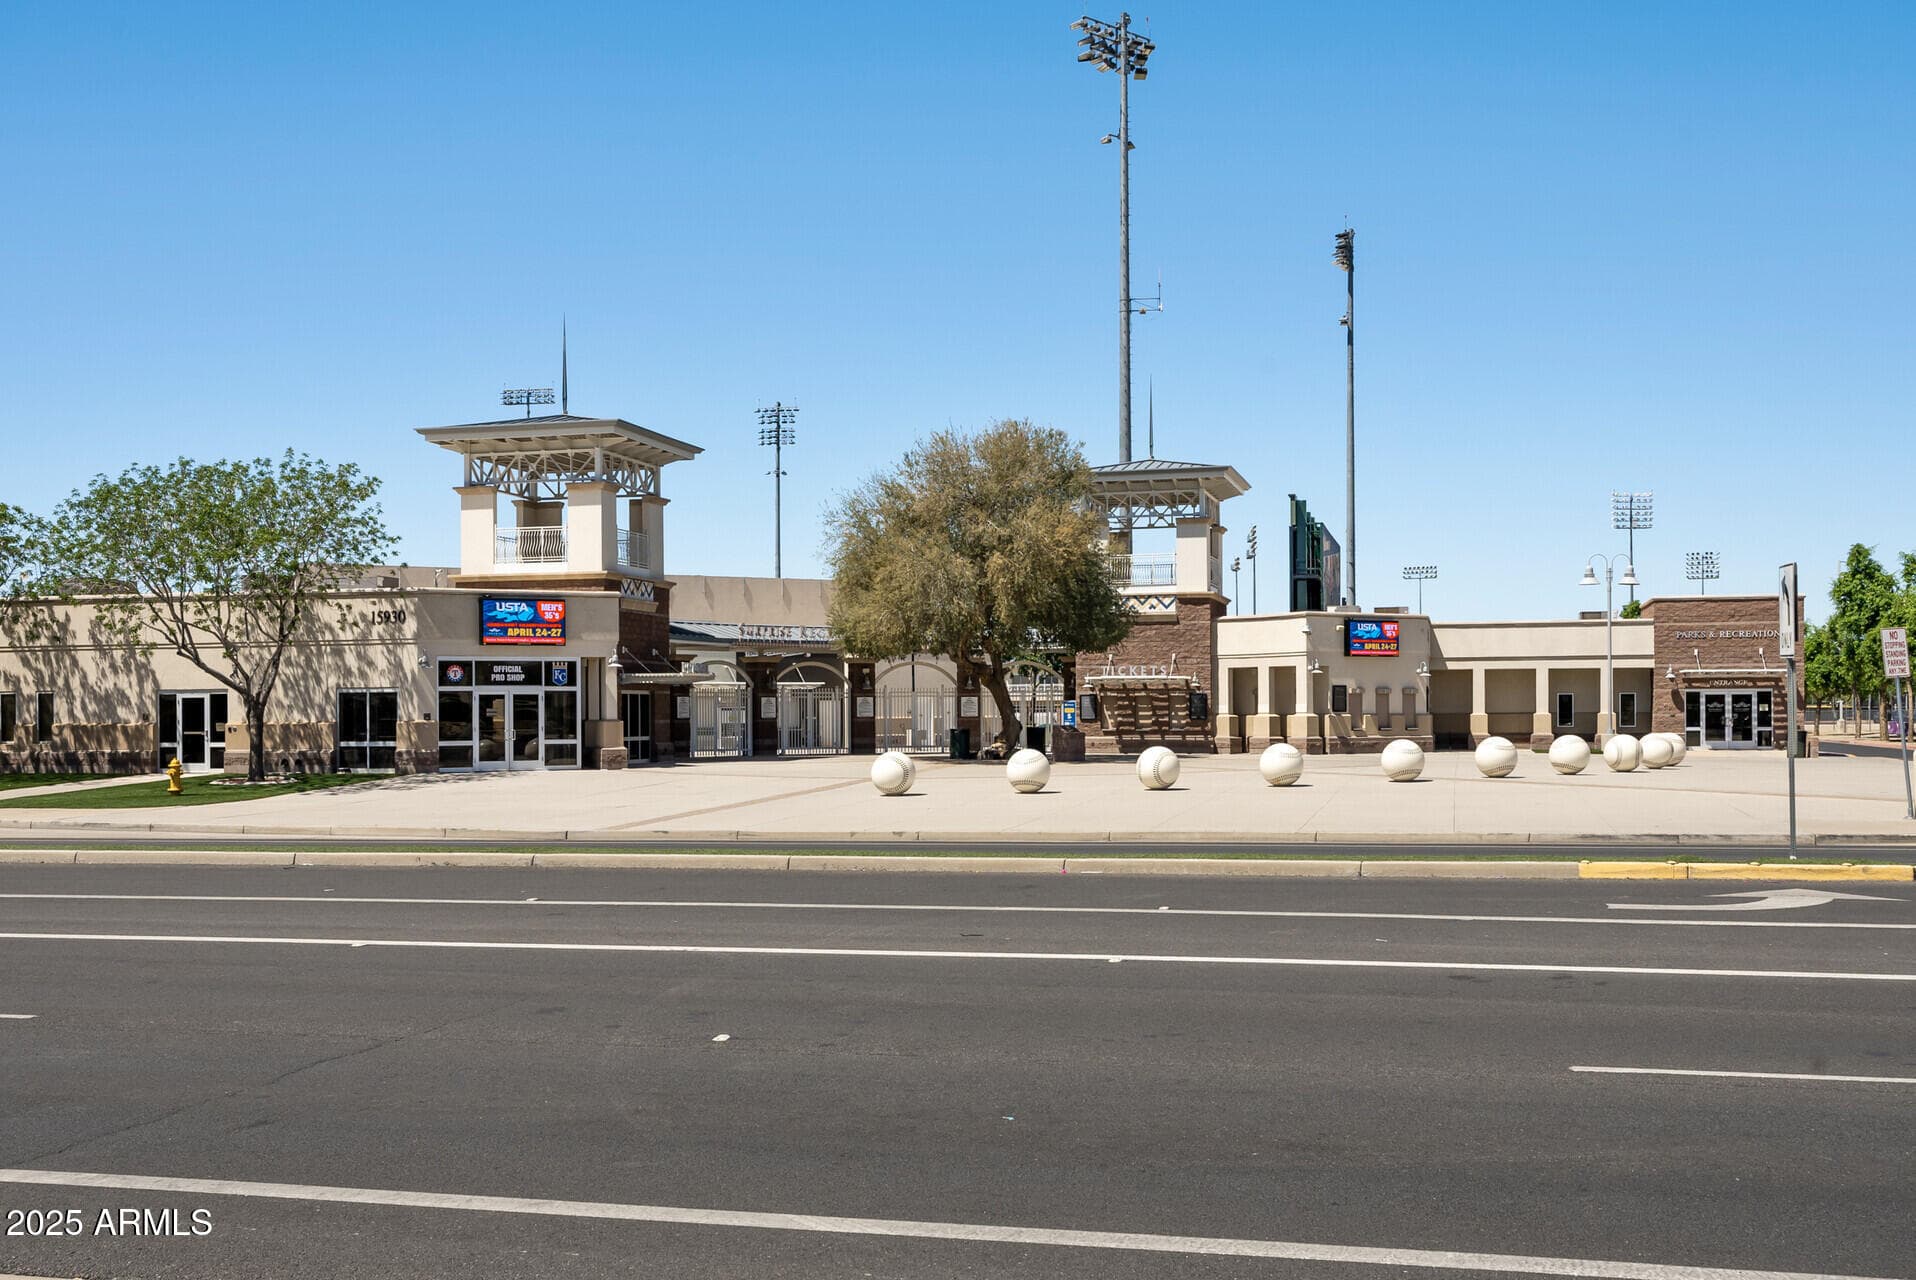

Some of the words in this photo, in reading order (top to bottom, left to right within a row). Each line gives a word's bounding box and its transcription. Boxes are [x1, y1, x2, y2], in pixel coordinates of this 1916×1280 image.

[495, 602, 528, 612] USTA
[371, 610, 406, 625] 15930
[1357, 623, 1376, 631] USTA
[507, 628, 534, 637] APRIL
[535, 628, 562, 637] 24-27
[1676, 630, 1706, 639] PARKS
[1709, 630, 1715, 638] &
[1720, 629, 1780, 638] RECREATION
[1889, 630, 1898, 640] NO
[493, 665, 523, 673] OFFICIAL
[1101, 665, 1167, 677] TICKETS
[491, 674, 505, 682] PRO
[507, 674, 525, 682] SHOP
[554, 670, 567, 681] KC
